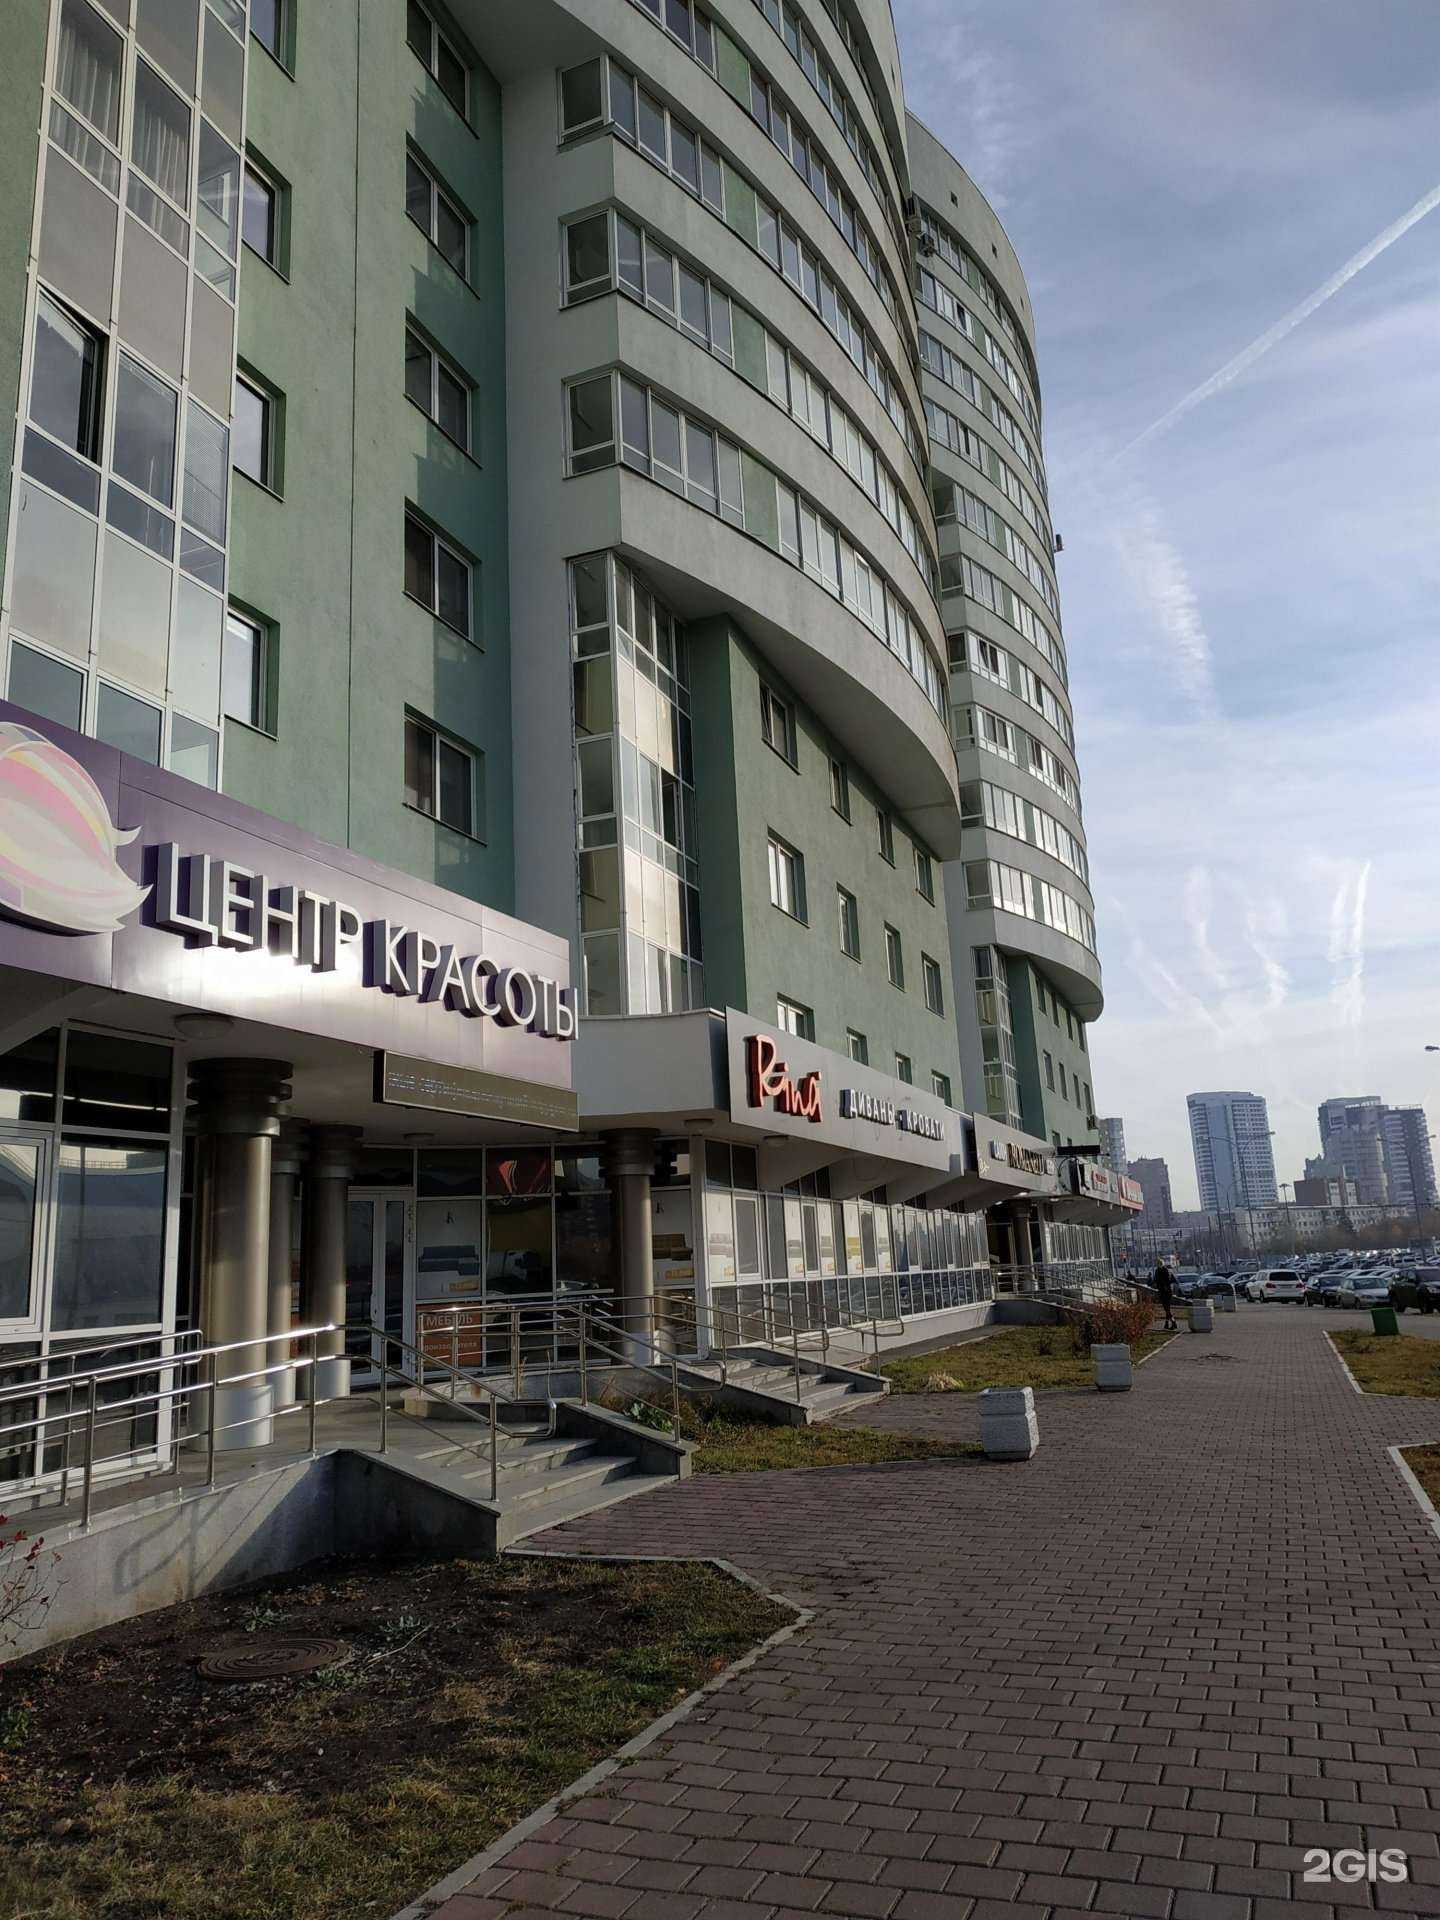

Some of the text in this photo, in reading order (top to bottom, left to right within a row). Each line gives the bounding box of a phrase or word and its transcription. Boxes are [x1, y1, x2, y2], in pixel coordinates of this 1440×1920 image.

[153, 841, 579, 1041] ЦЕНТР КРАСОТЫ
[846, 1088, 896, 1126] ДИВАНЫ
[905, 1109, 946, 1141] КРОВАТИ
[425, 1312, 474, 1329] МЕБЛЬ
